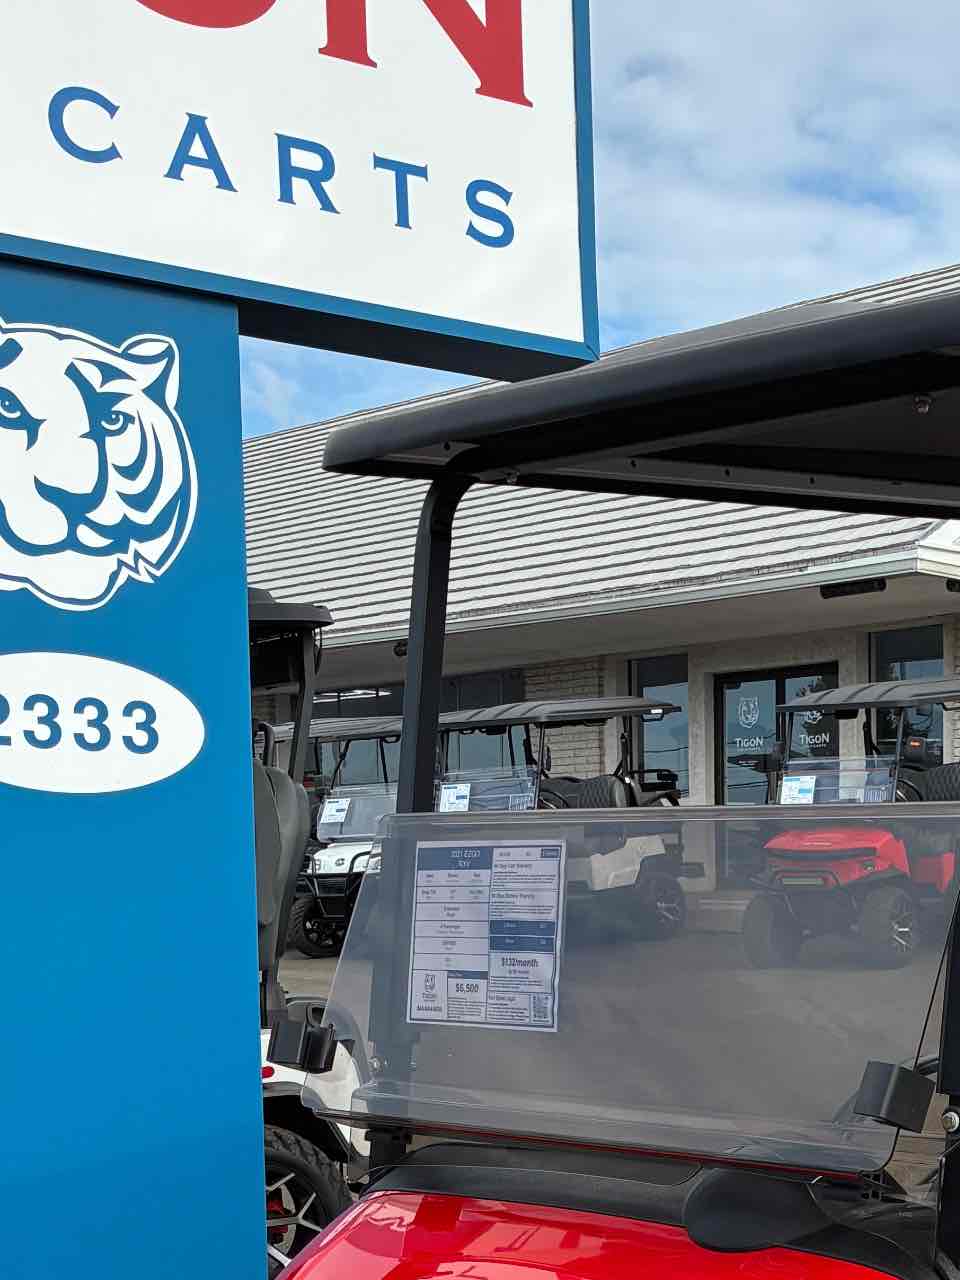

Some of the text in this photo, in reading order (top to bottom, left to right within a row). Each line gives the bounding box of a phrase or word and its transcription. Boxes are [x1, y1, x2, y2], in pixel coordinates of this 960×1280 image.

[48, 86, 516, 248] CARTS
[735, 737, 764, 748] TIGON
[800, 733, 830, 744] TIGON
